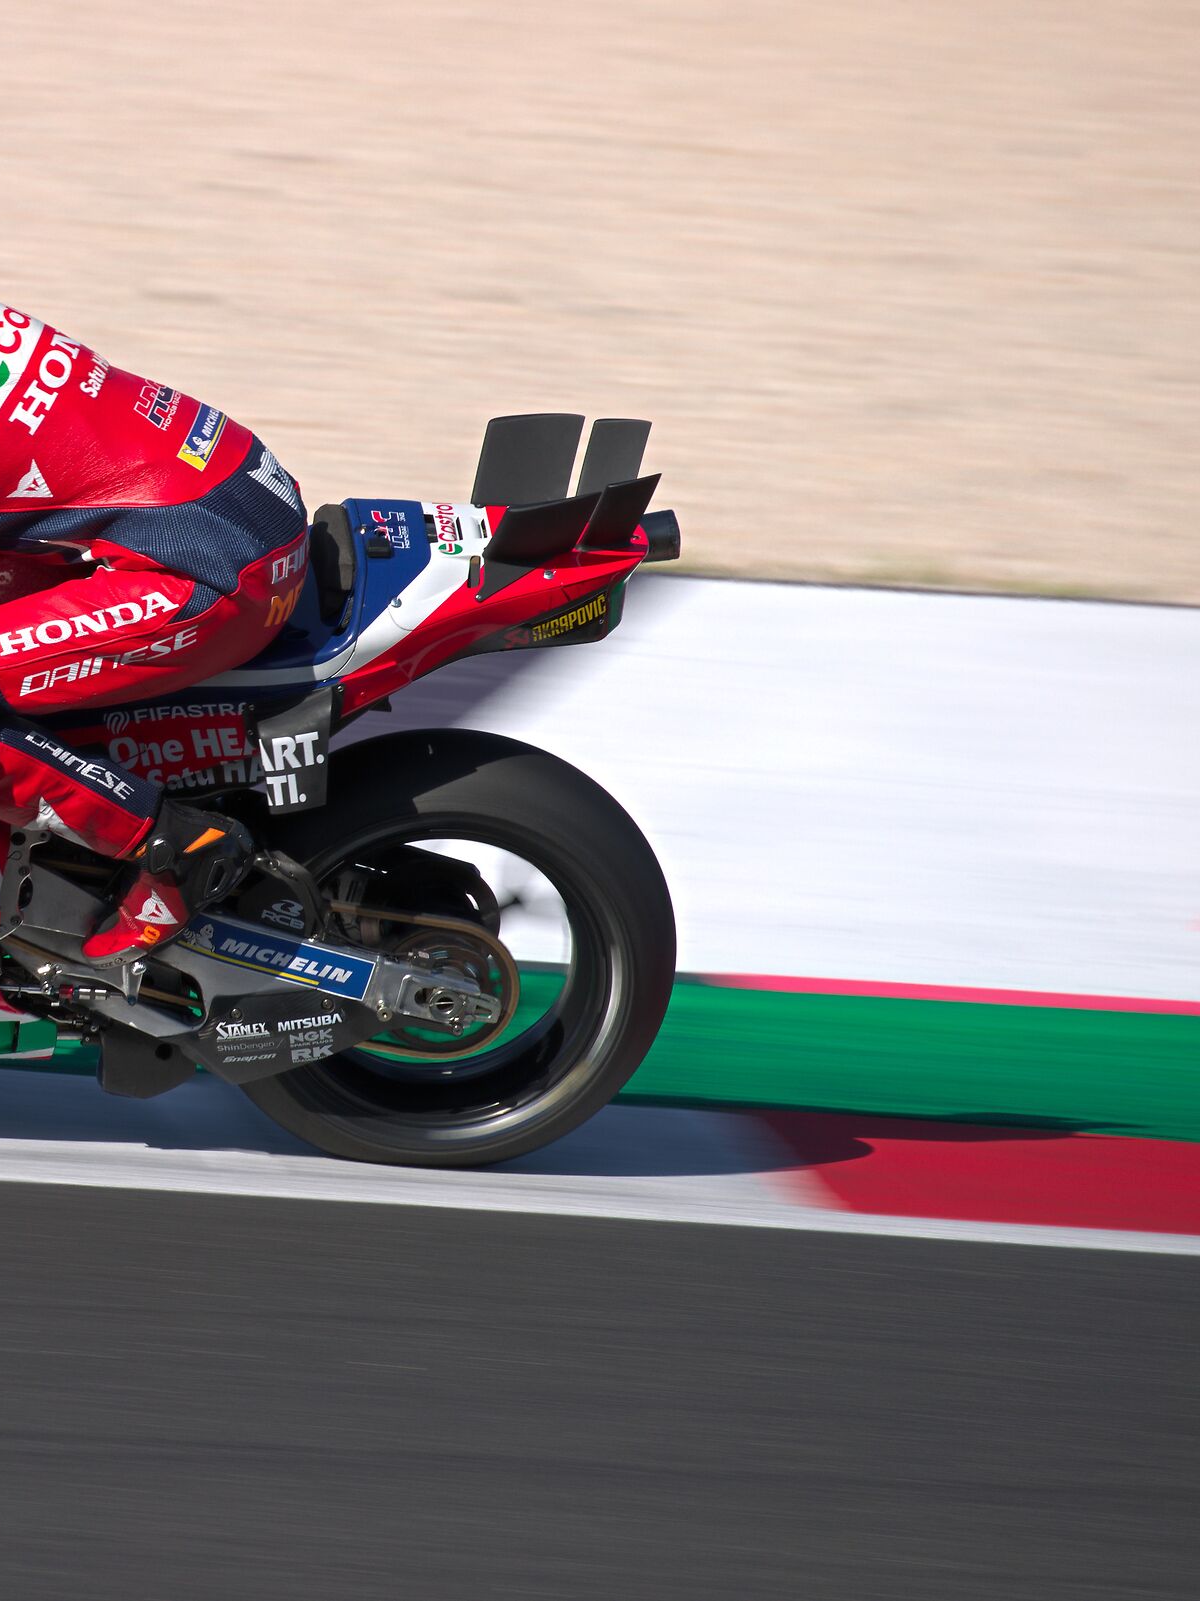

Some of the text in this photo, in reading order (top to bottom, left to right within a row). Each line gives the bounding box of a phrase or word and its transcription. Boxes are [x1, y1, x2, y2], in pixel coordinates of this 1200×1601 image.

[436, 502, 458, 542] Castro
[19, 625, 198, 696] DAINESE
[108, 736, 184, 770] One
[25, 730, 136, 800] DAINESE
[261, 909, 305, 930] RCB
[220, 937, 353, 984] MICHELIN
[216, 1021, 270, 1041] STANLEY
[277, 1012, 343, 1032] MITSUBA
[289, 1028, 333, 1044] NGK
[223, 1052, 277, 1064] Snap-on
[291, 1044, 334, 1061] RK
